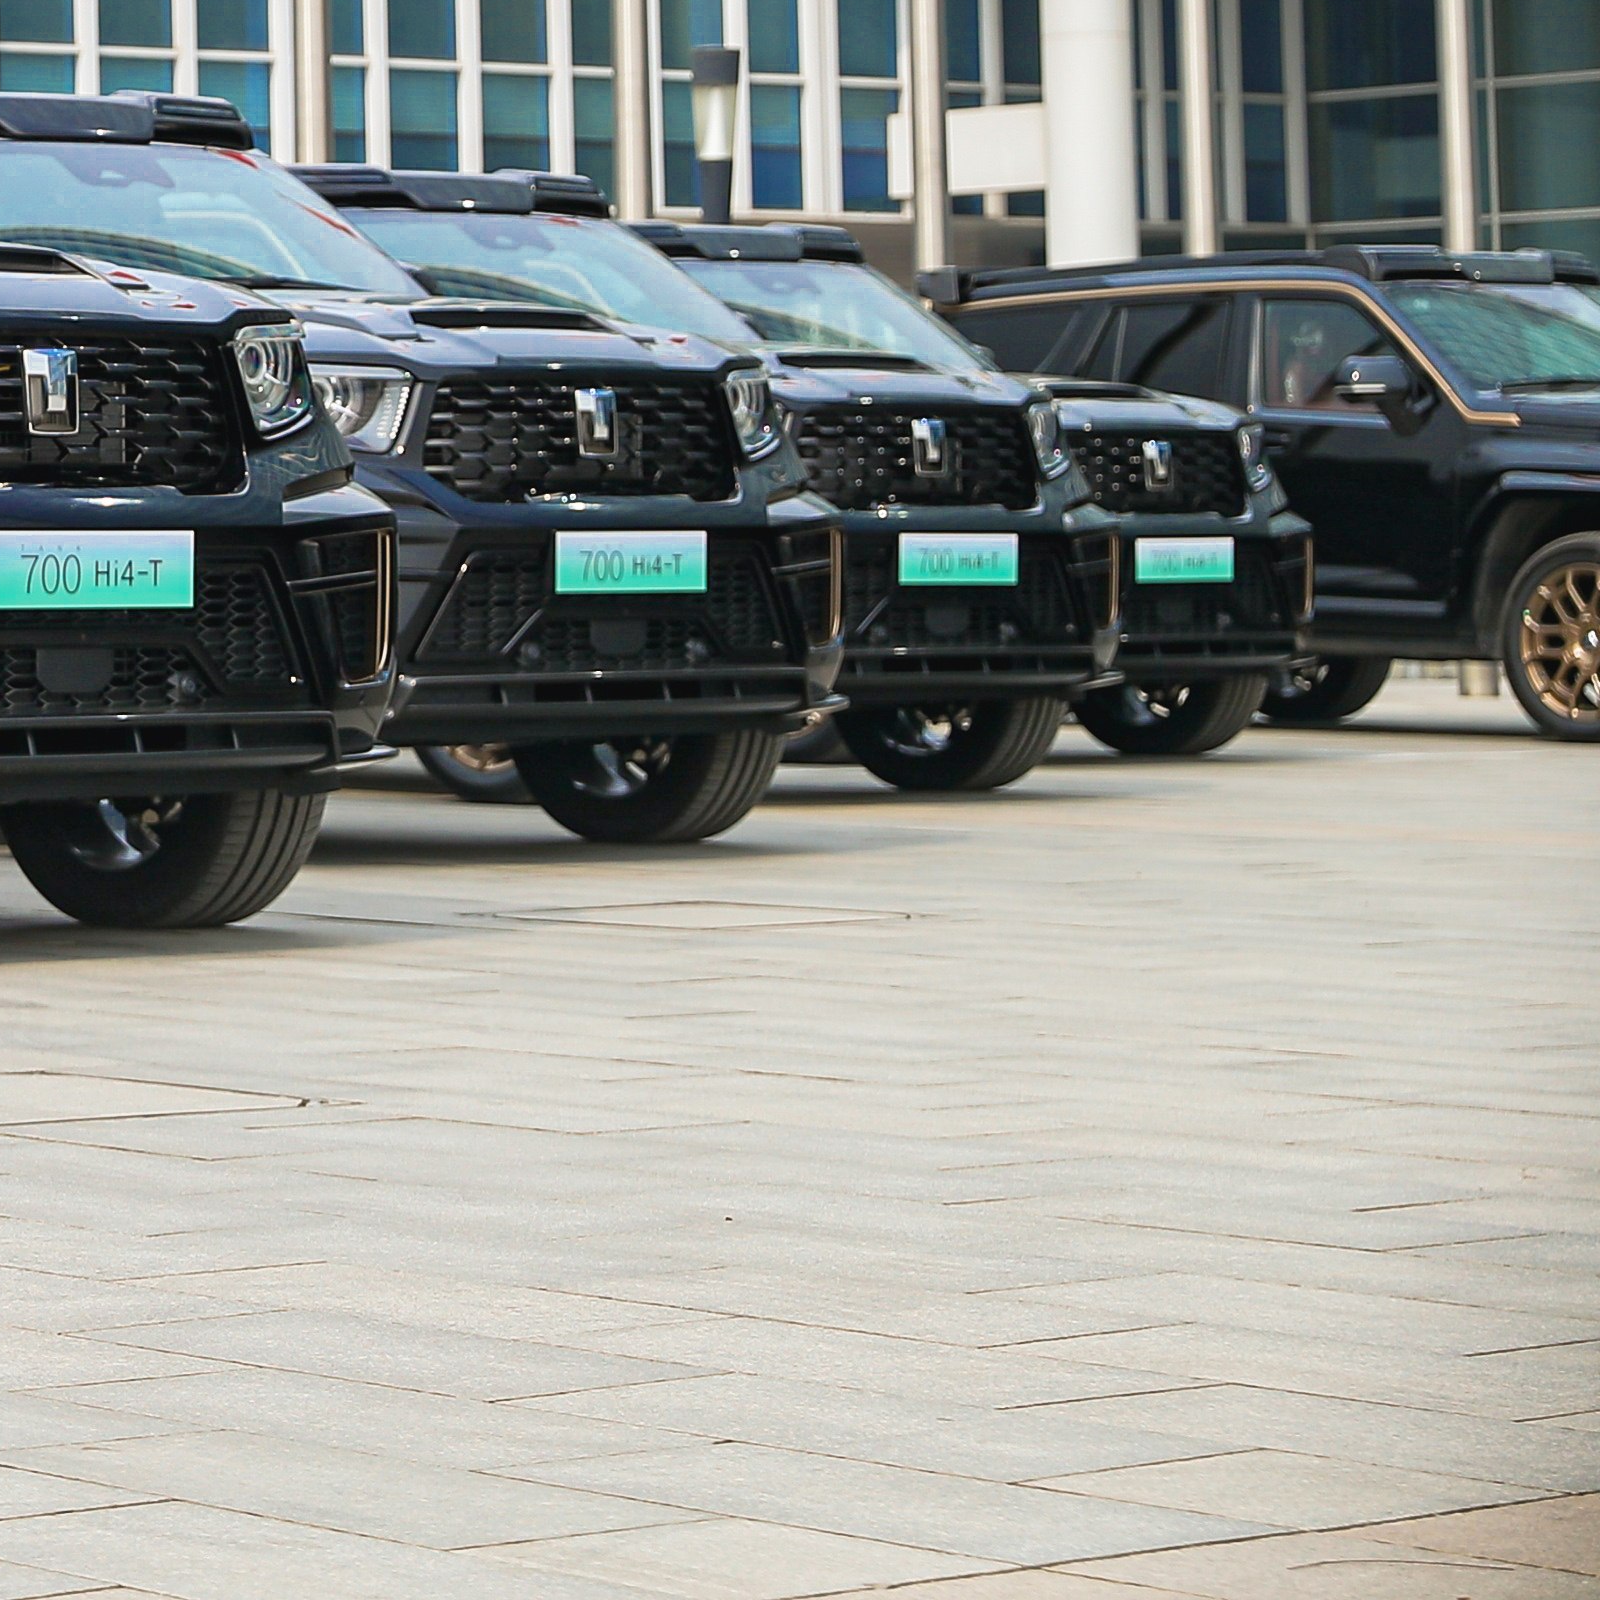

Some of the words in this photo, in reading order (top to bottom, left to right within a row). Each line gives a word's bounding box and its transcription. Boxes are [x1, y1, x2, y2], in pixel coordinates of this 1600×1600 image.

[21, 554, 81, 594] 700
[95, 559, 163, 587] Hi4-T
[579, 550, 625, 582] 700
